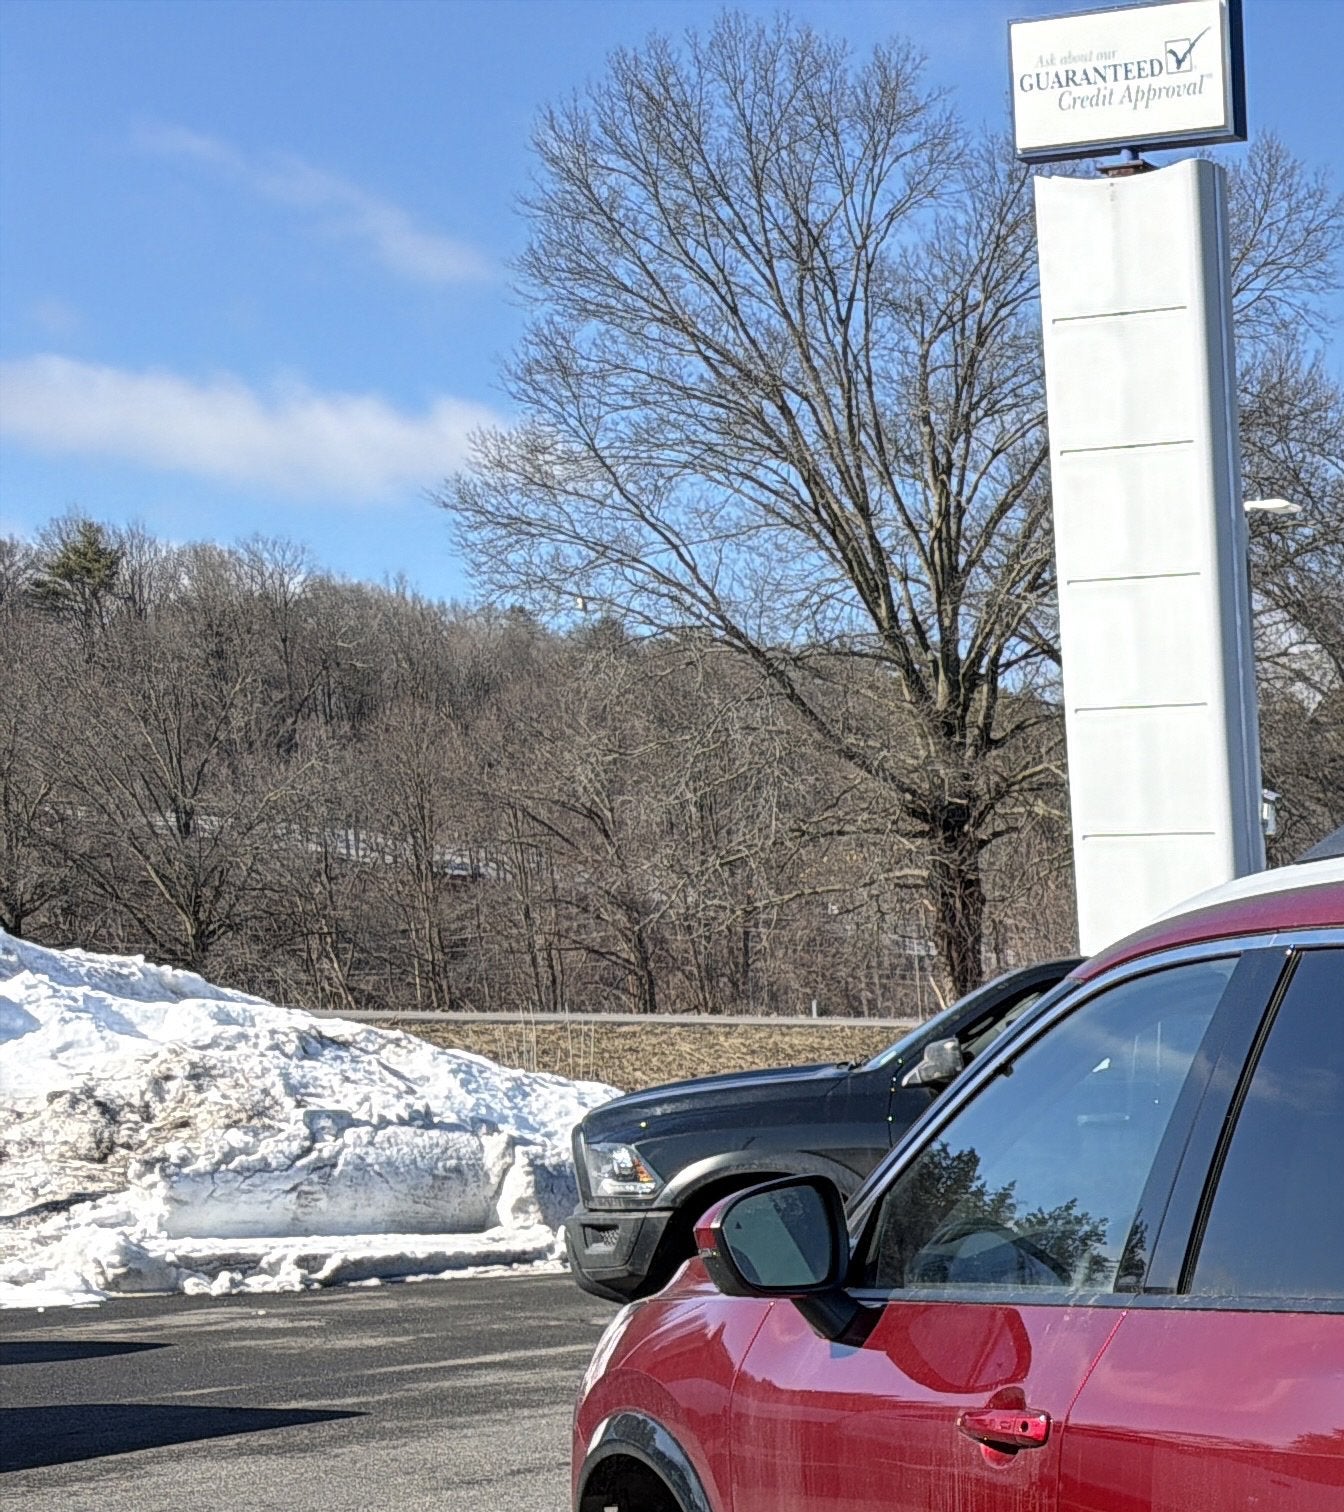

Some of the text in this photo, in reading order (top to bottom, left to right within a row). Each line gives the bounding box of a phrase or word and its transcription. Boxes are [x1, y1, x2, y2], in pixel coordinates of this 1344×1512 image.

[1019, 58, 1163, 92] GUARANTEED
[1034, 50, 1117, 68] Ask about our
[1058, 75, 1205, 111] Credit Approval
